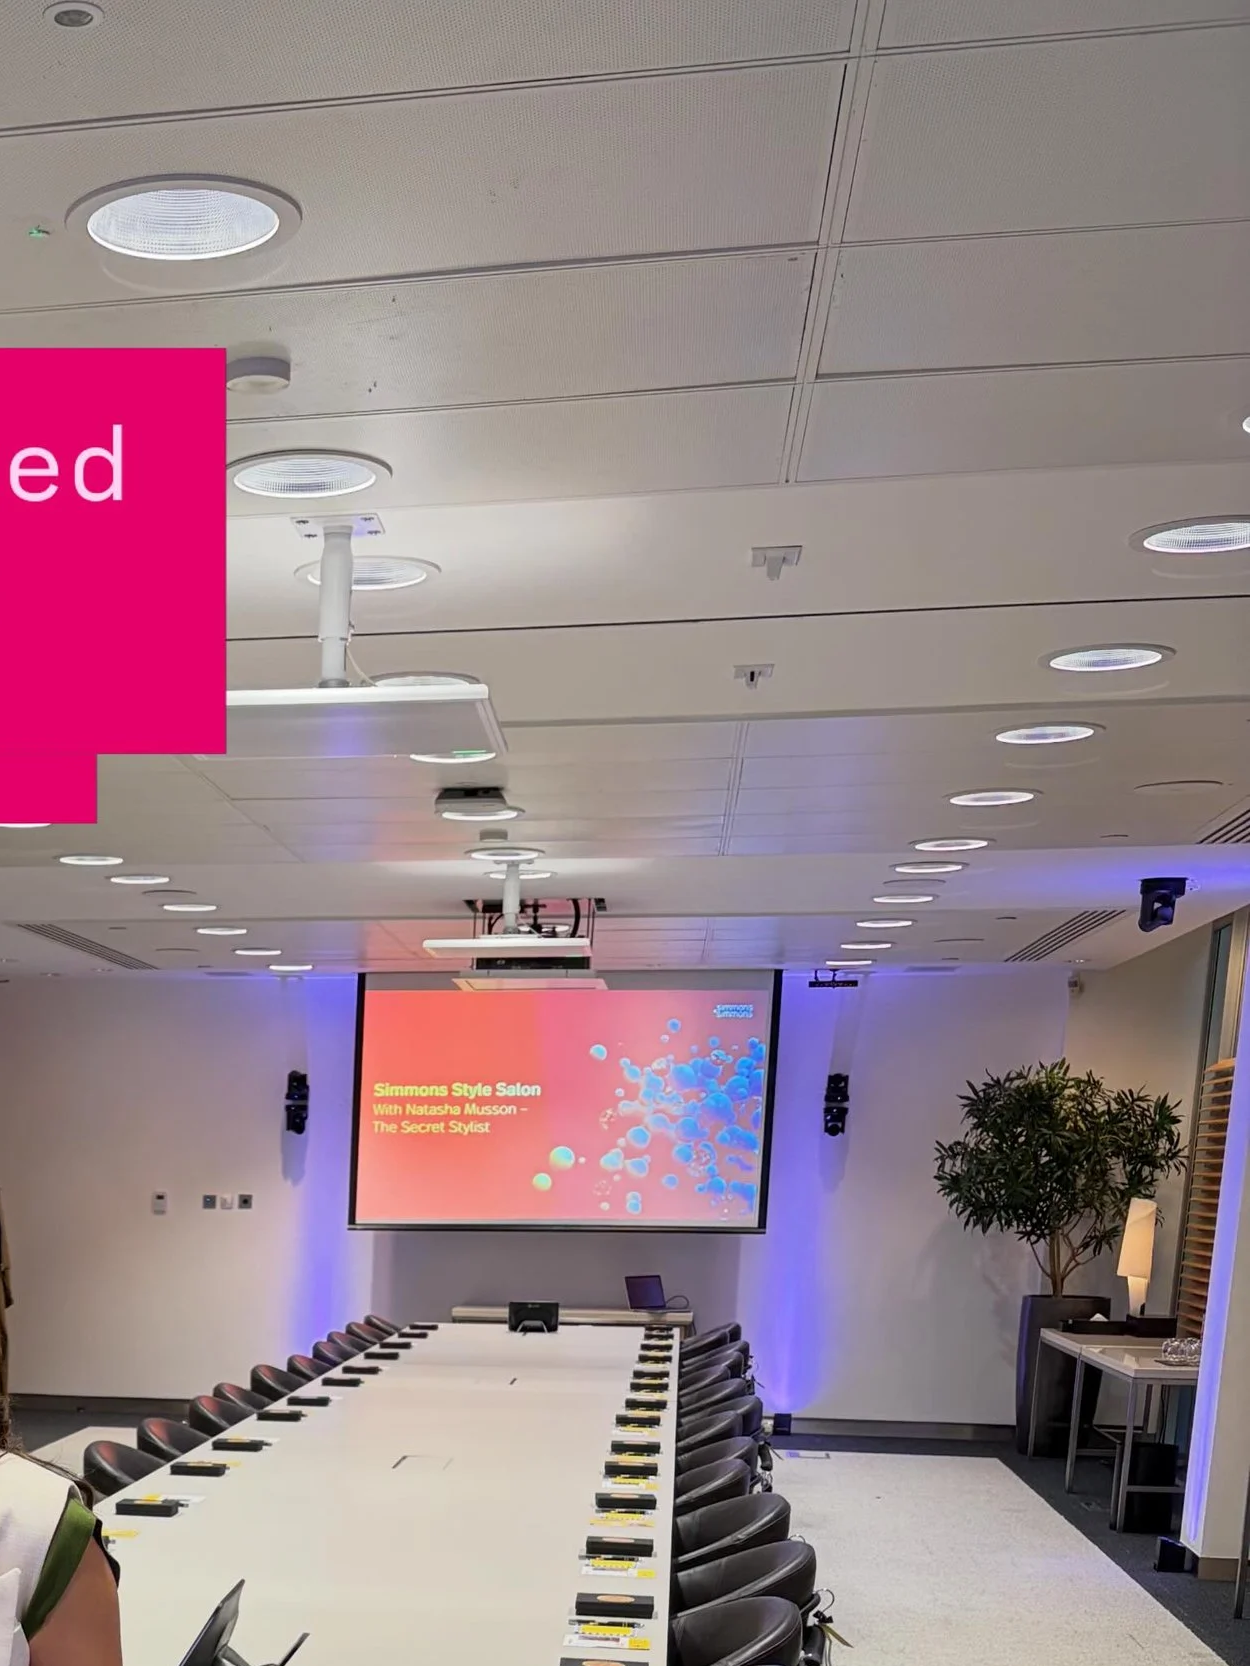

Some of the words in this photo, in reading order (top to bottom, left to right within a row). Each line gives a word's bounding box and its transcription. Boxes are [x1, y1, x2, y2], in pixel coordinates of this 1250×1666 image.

[373, 1083, 448, 1097] Simmons
[451, 1082, 492, 1099] Style
[495, 1082, 541, 1097] Salon
[372, 1104, 402, 1116] With
[405, 1103, 461, 1116] Natasha
[464, 1103, 517, 1116] Musson
[372, 1121, 398, 1134] The
[400, 1121, 445, 1134] Secret
[448, 1121, 491, 1136] Stylist
